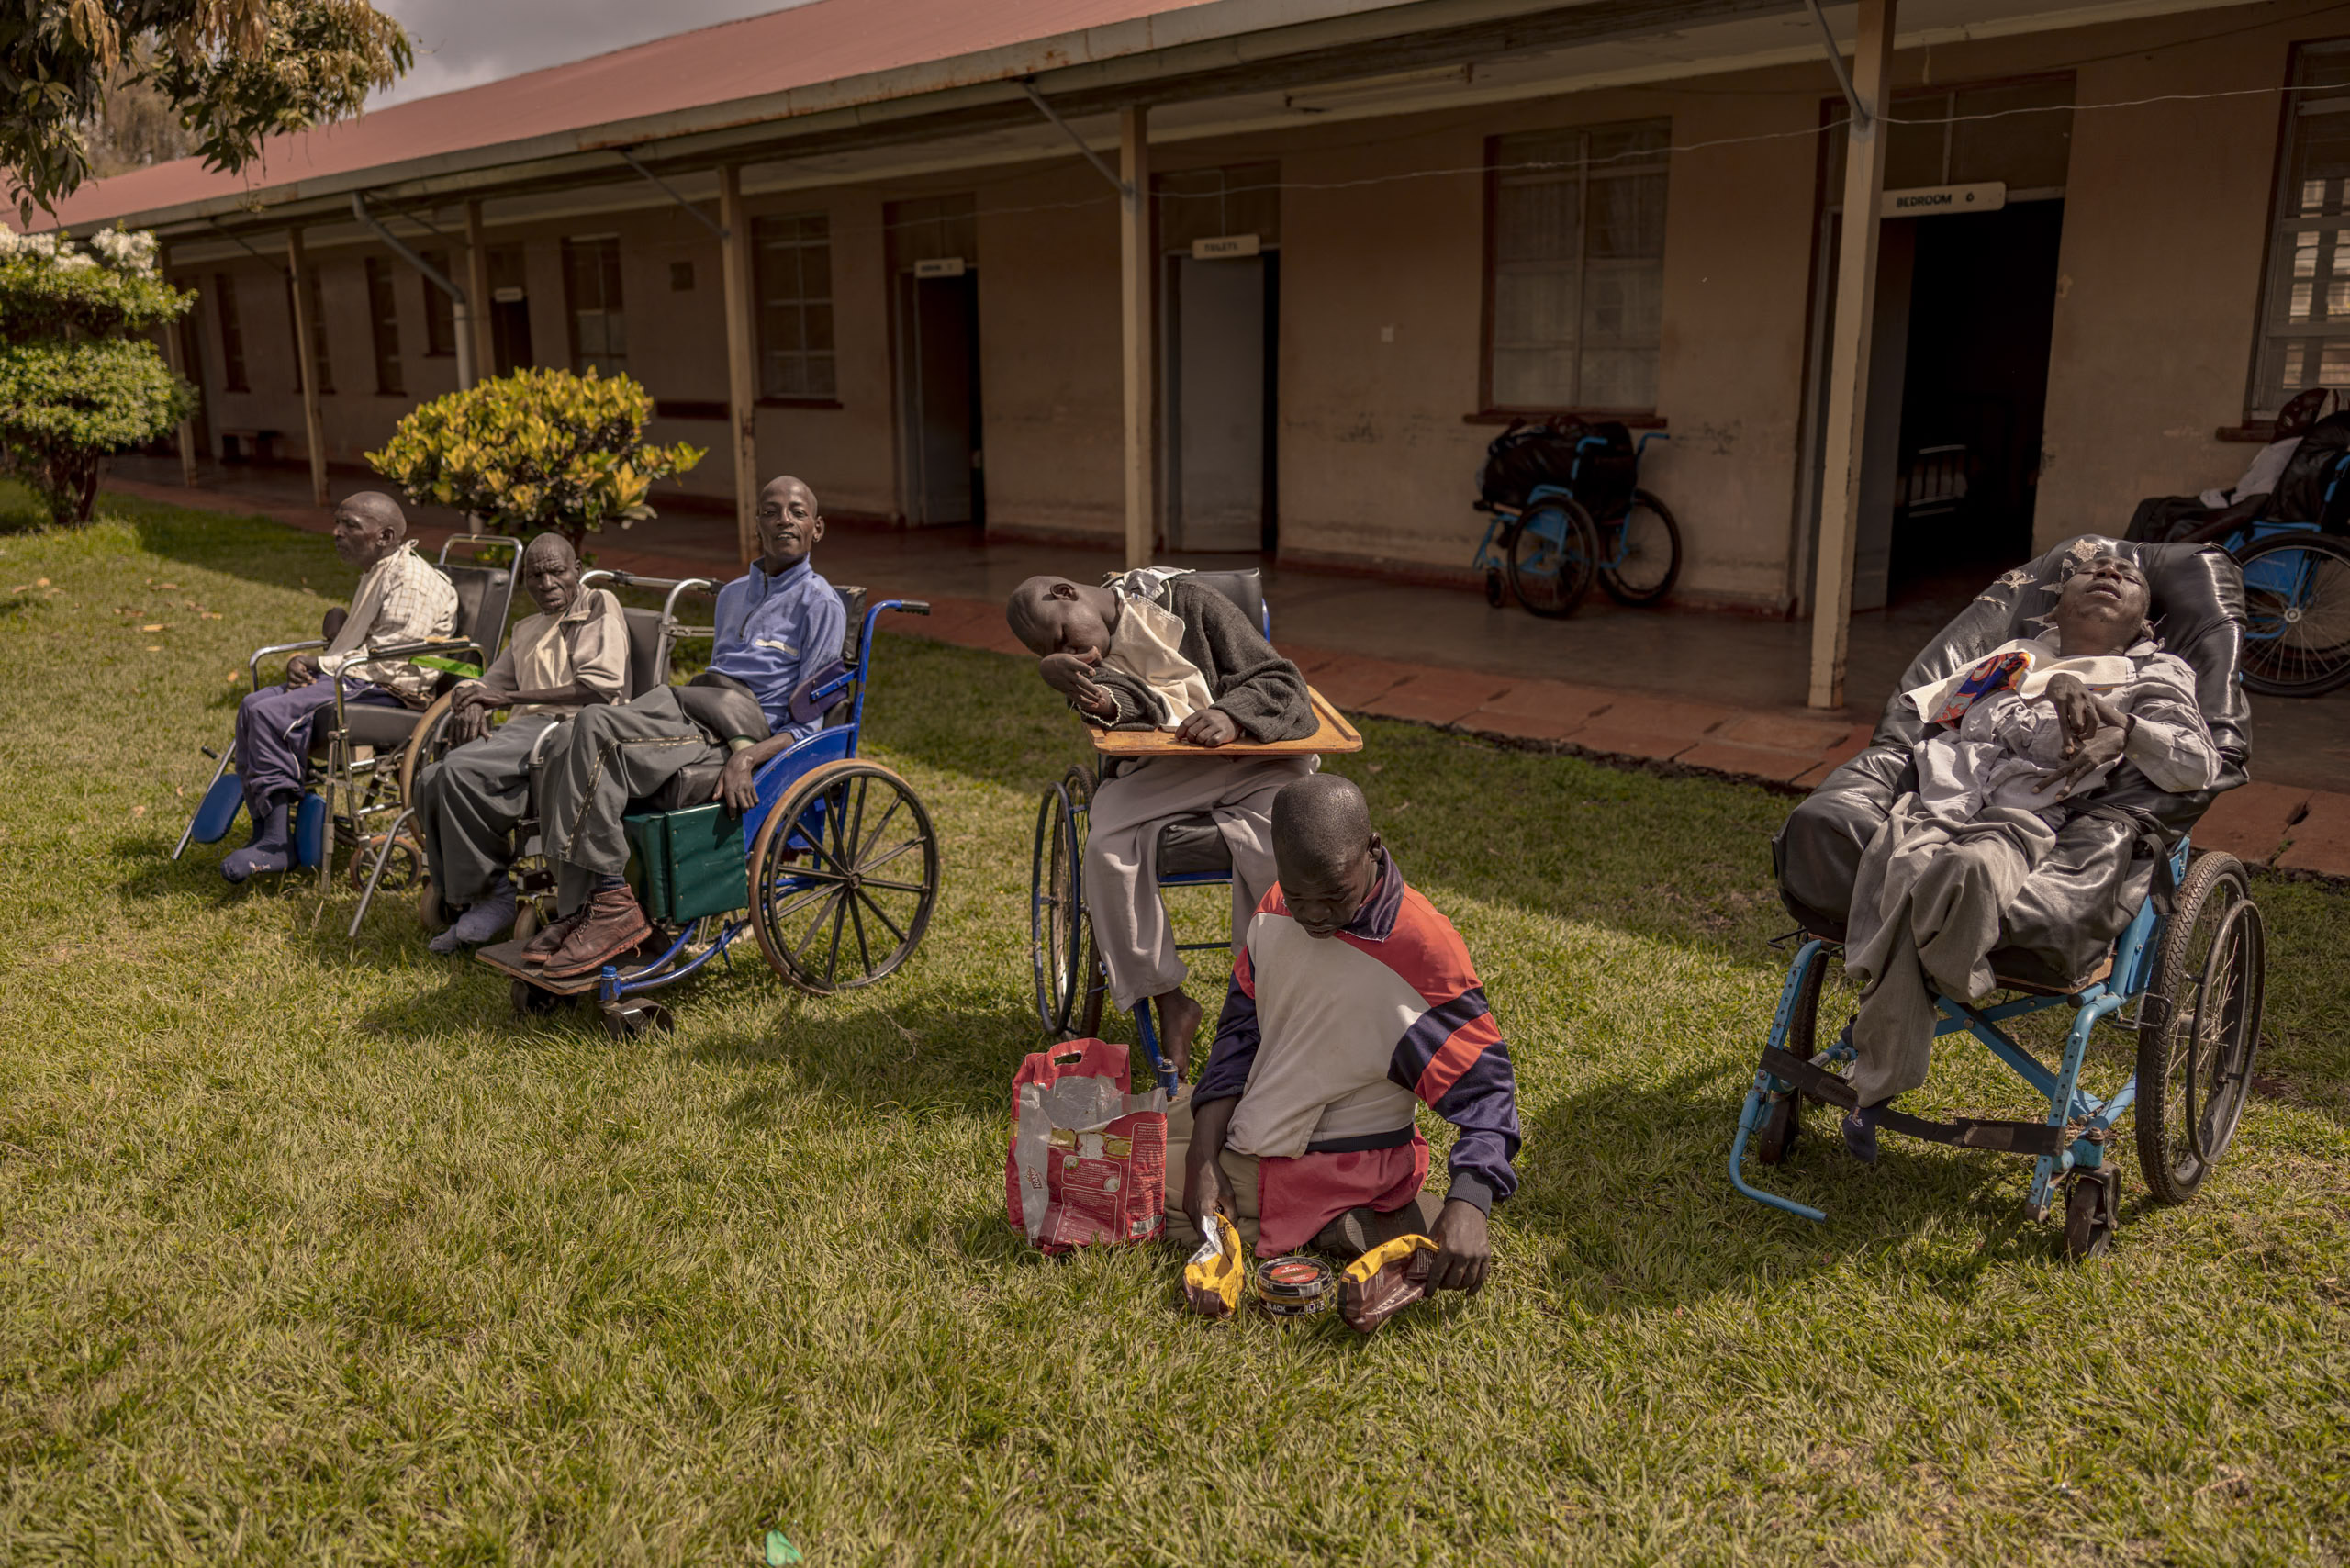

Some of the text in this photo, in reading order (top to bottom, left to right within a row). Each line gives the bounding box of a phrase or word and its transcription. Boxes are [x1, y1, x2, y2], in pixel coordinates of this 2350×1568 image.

[1897, 191, 1975, 208] BEDROOM 6
[1266, 1303, 1286, 1313] BLACK
